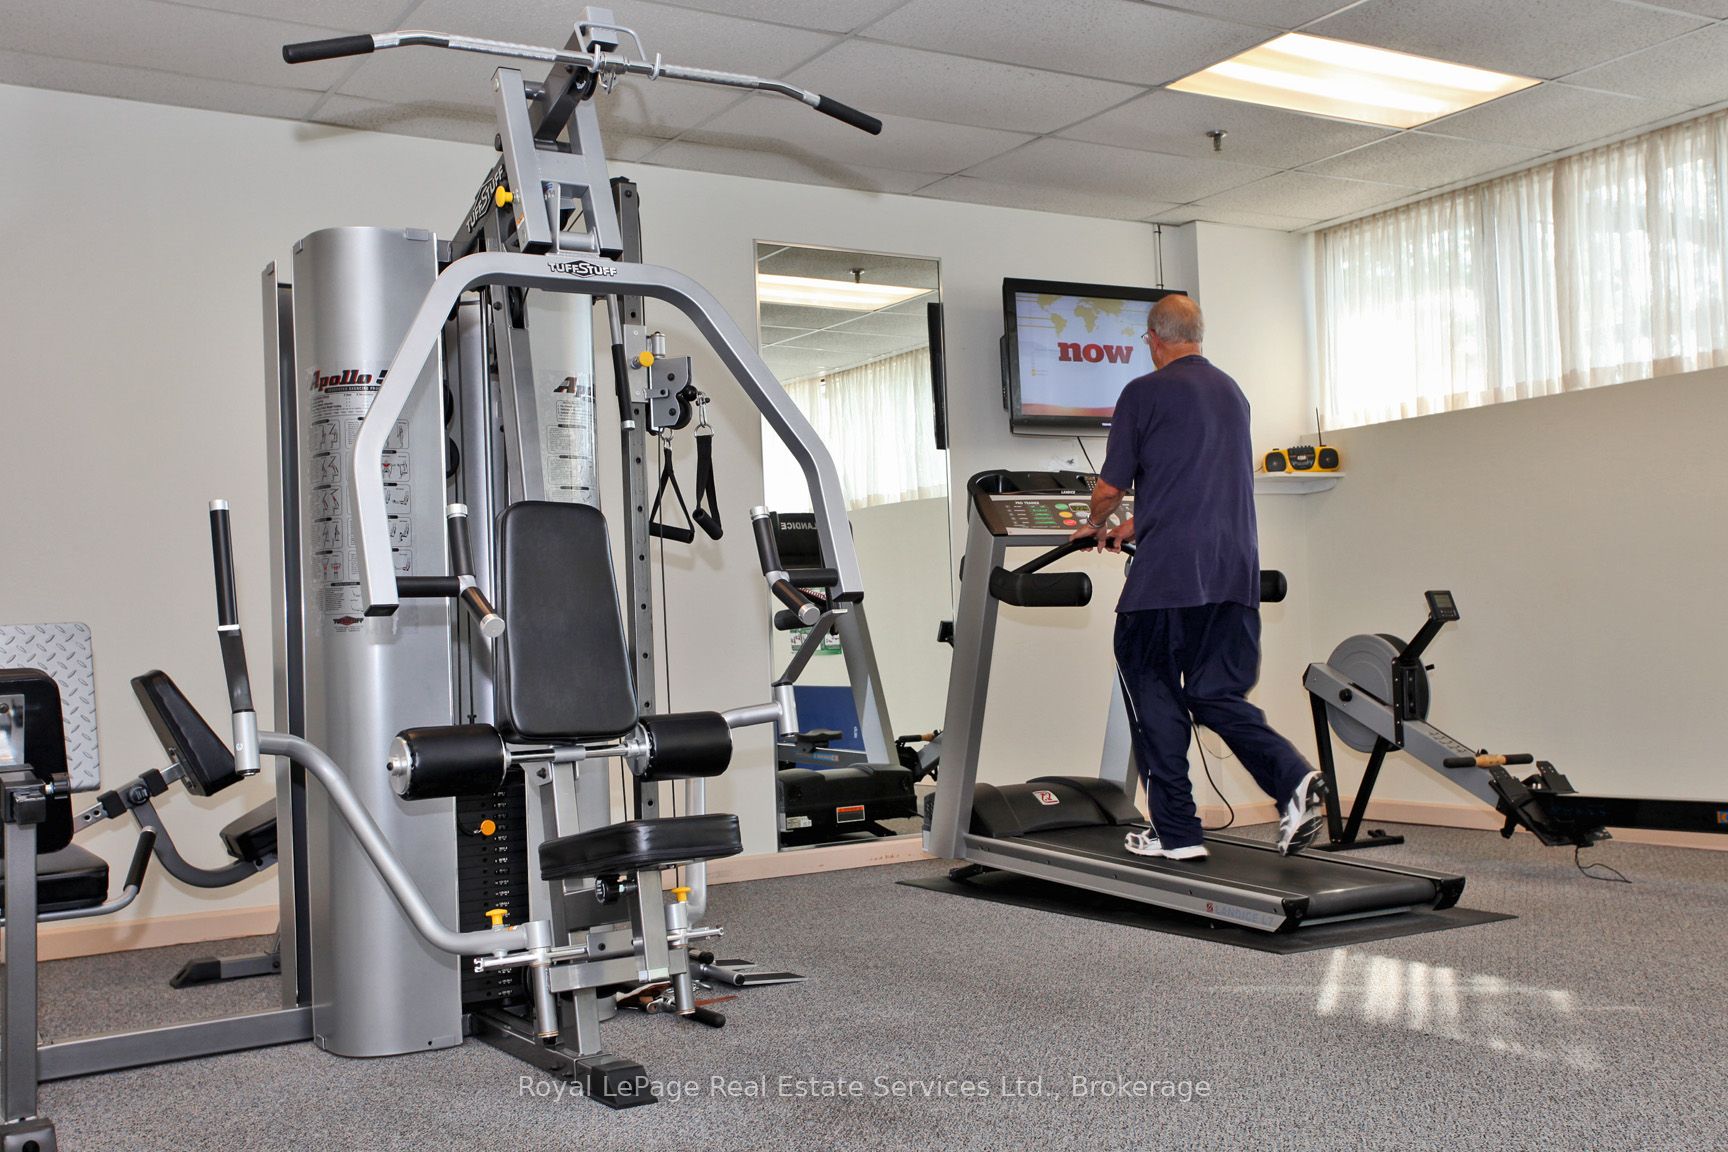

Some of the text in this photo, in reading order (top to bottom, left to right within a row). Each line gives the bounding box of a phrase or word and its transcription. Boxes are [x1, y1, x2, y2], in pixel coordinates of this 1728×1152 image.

[466, 164, 504, 233] TUFFSTUFF
[547, 261, 617, 277] TUFFSTUFF
[1057, 342, 1134, 364] now
[310, 369, 373, 392] Apollo
